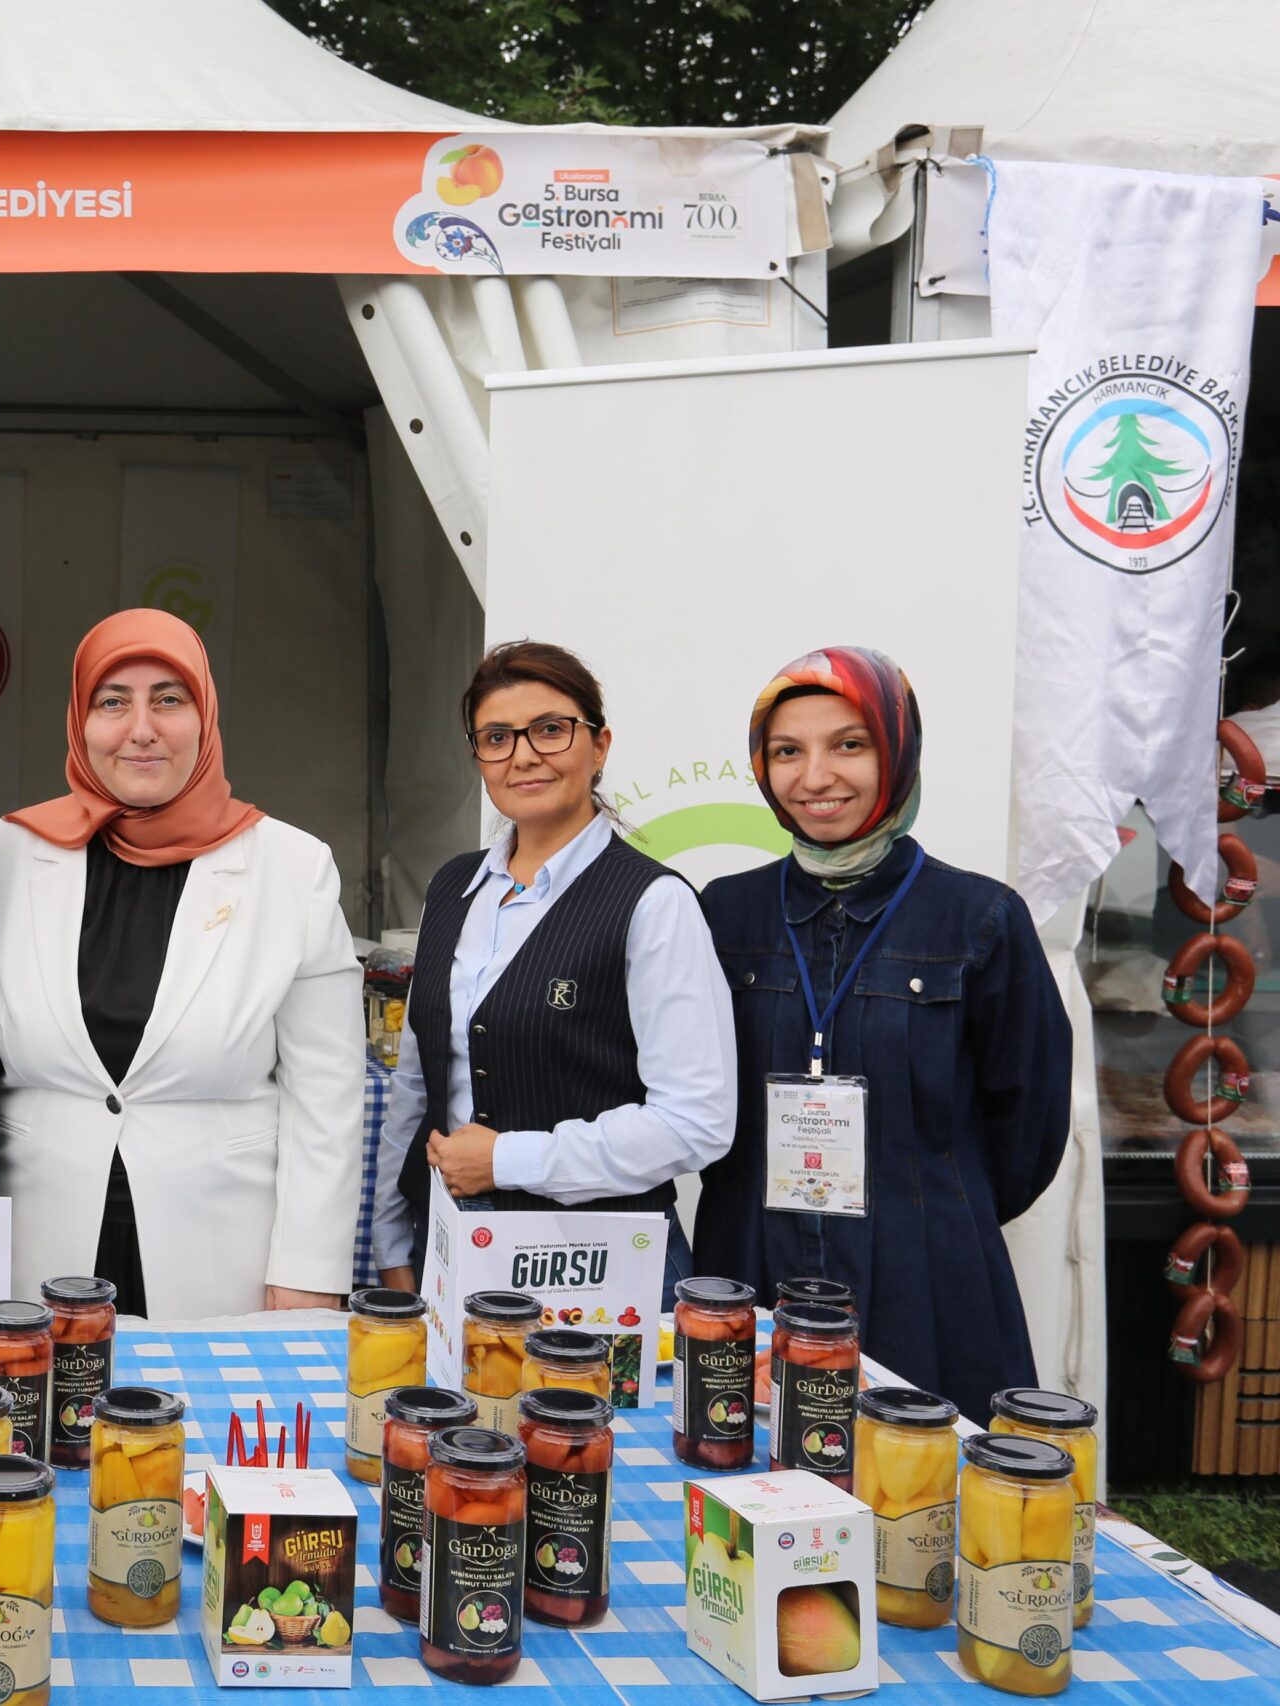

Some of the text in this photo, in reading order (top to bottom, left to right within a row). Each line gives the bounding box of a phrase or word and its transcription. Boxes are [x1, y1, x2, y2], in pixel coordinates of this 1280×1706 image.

[543, 184, 620, 202] 5. Bursa
[683, 203, 738, 231] 700
[541, 231, 622, 252] Festivali
[1098, 354, 1198, 386] BELEDİYE
[1092, 381, 1170, 405] HARMANCIK
[1128, 557, 1149, 569] 1973
[511, 1249, 609, 1289] GÜRSU
[389, 1480, 425, 1502] GürD
[284, 1529, 343, 1558] GÜRSU
[454, 1578, 480, 1588] ARMUT
[692, 1562, 744, 1616] GÜRSU
[701, 1594, 738, 1623] Armudu
